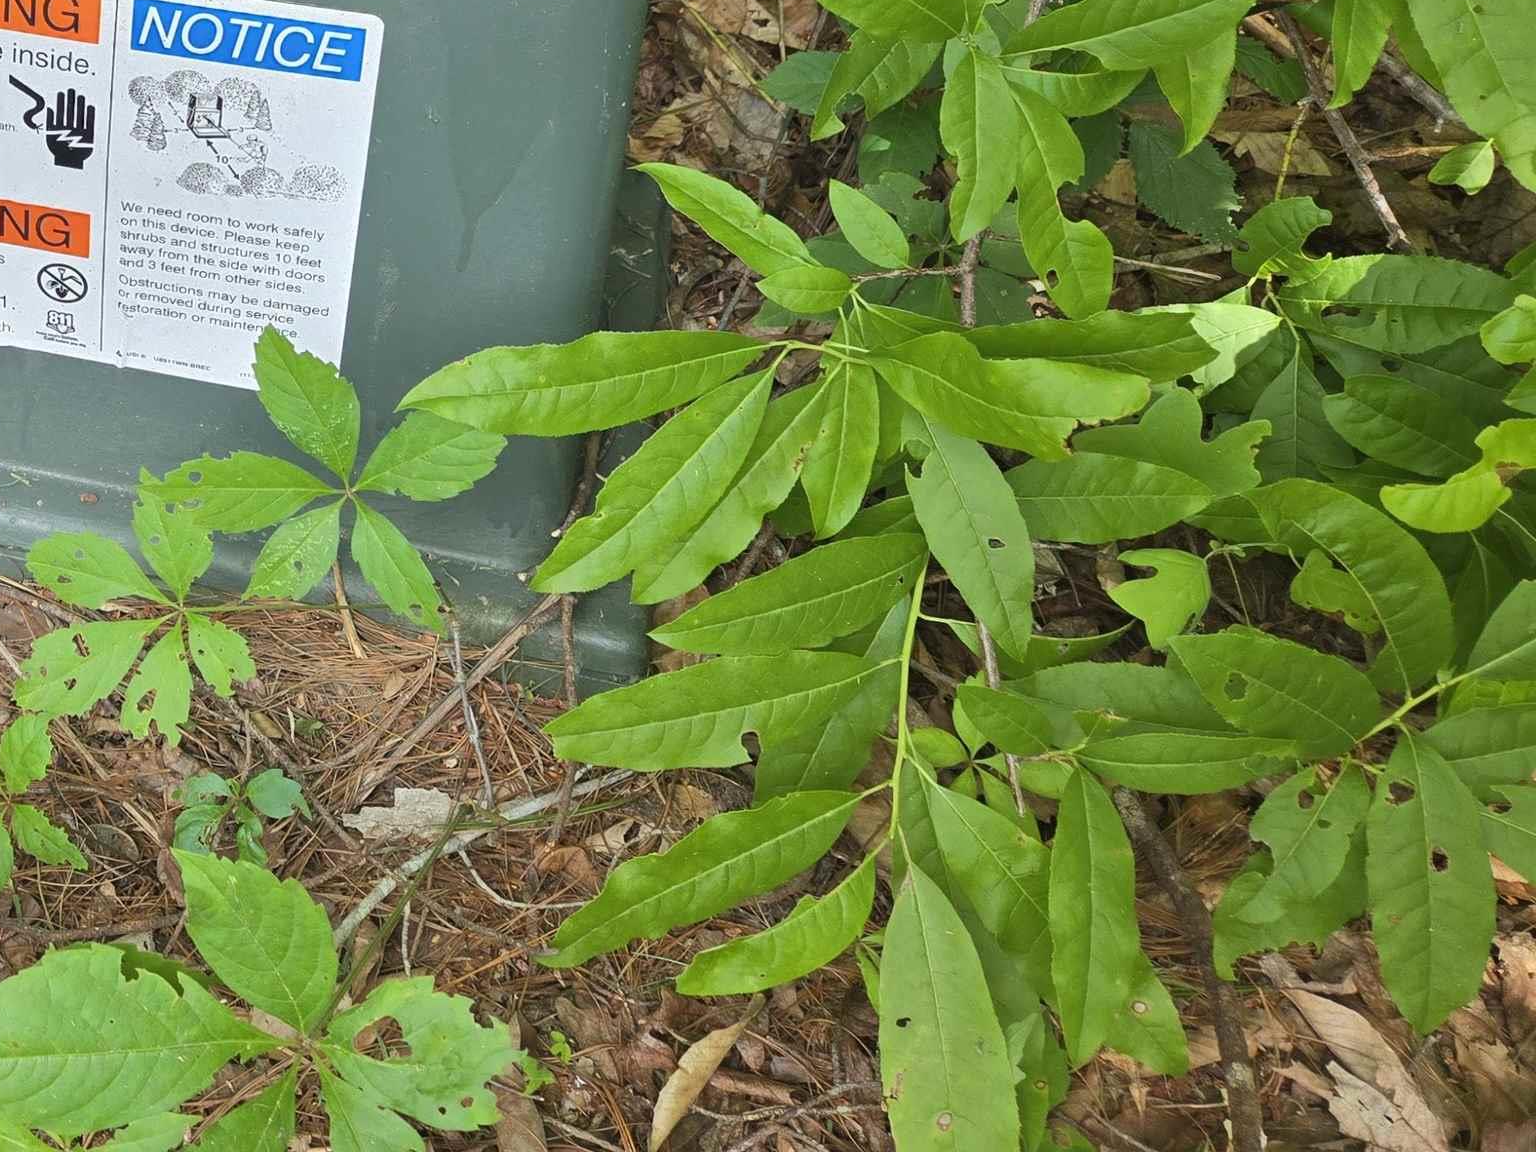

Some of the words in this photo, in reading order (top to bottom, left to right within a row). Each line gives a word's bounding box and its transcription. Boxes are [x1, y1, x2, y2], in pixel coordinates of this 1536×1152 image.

[138, 6, 353, 73] NOTICE
[12, 43, 96, 76] inside.
[121, 201, 143, 213] We
[147, 205, 181, 219] need
[186, 212, 223, 226] room
[227, 217, 240, 228] to
[245, 221, 278, 233] work
[284, 225, 325, 241] safely
[121, 217, 137, 227] on
[142, 218, 166, 230] this
[171, 222, 217, 239] device.
[224, 231, 270, 247] Please
[275, 238, 310, 253] keep
[120, 230, 166, 244] shrubs
[170, 236, 196, 248] and
[201, 241, 270, 261] structures
[275, 253, 291, 264] 10
[296, 256, 322, 268] feet
[120, 244, 153, 258] away
[158, 248, 189, 262] from
[194, 253, 215, 266] the
[219, 258, 248, 271] side
[252, 263, 280, 276] with
[285, 268, 325, 283] doors
[119, 257, 144, 268] and
[148, 260, 156, 269] 3
[161, 262, 186, 275] feet
[190, 267, 221, 280] from
[225, 273, 261, 287] other
[265, 279, 305, 294] sides.
[118, 289, 131, 299] or
[135, 291, 193, 309] removed
[198, 298, 241, 318] during
[245, 308, 294, 325] service
[118, 302, 187, 320] restoration
[192, 312, 205, 322] or
[119, 275, 203, 297] Obstructions
[208, 290, 237, 303] may
[241, 294, 259, 305] be
[263, 297, 329, 317] damaged
[49, 311, 72, 327] 811
